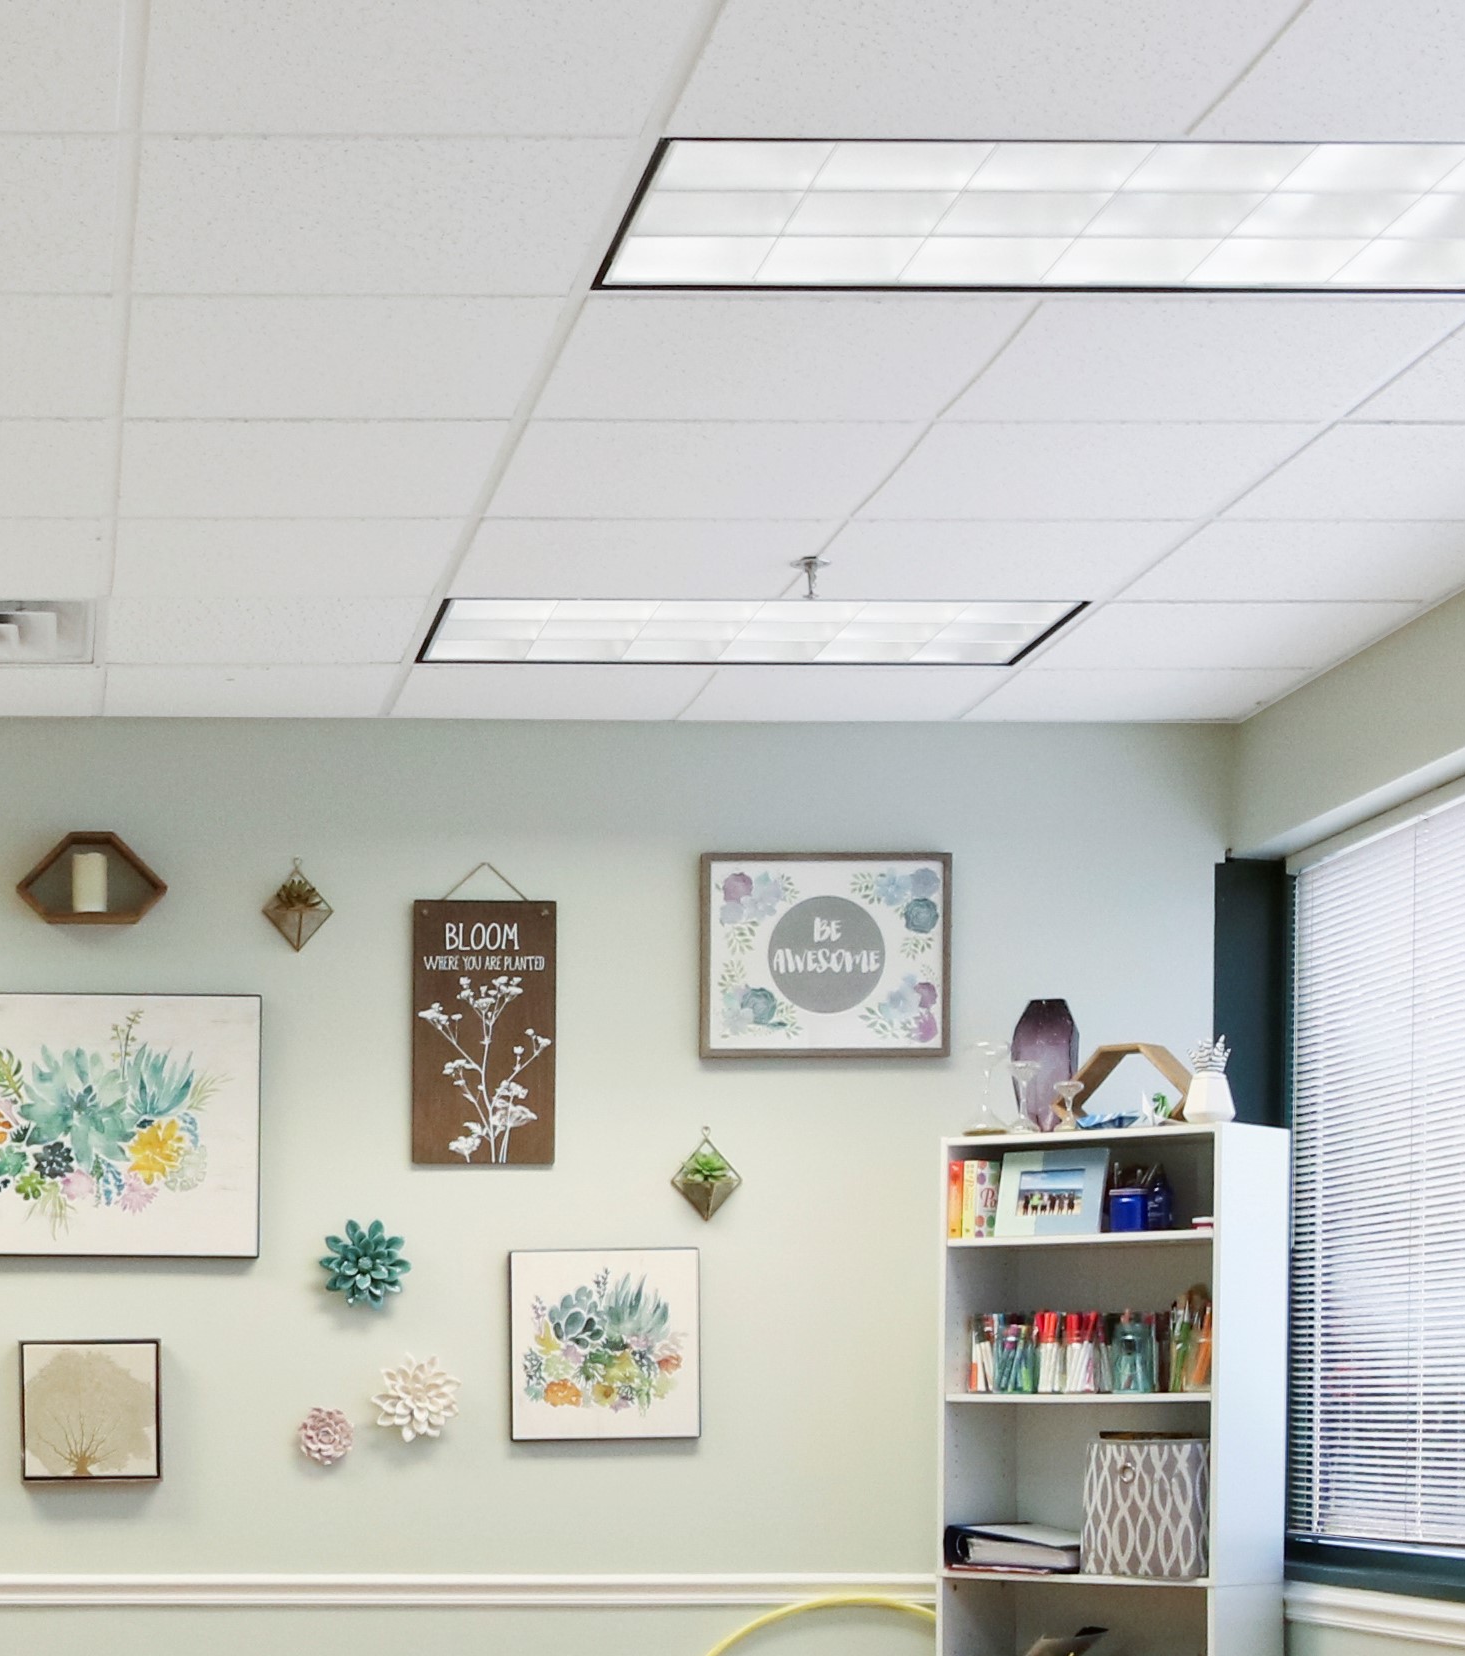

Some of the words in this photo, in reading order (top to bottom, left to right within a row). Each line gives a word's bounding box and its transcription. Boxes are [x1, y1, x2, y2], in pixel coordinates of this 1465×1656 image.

[445, 922, 520, 951] BLOOM
[813, 916, 842, 943] BE
[423, 955, 460, 971] WHERE
[462, 955, 482, 971] YOU
[484, 955, 502, 971] ARE
[503, 955, 545, 971] PLANTED
[773, 948, 881, 974] AWESOME
